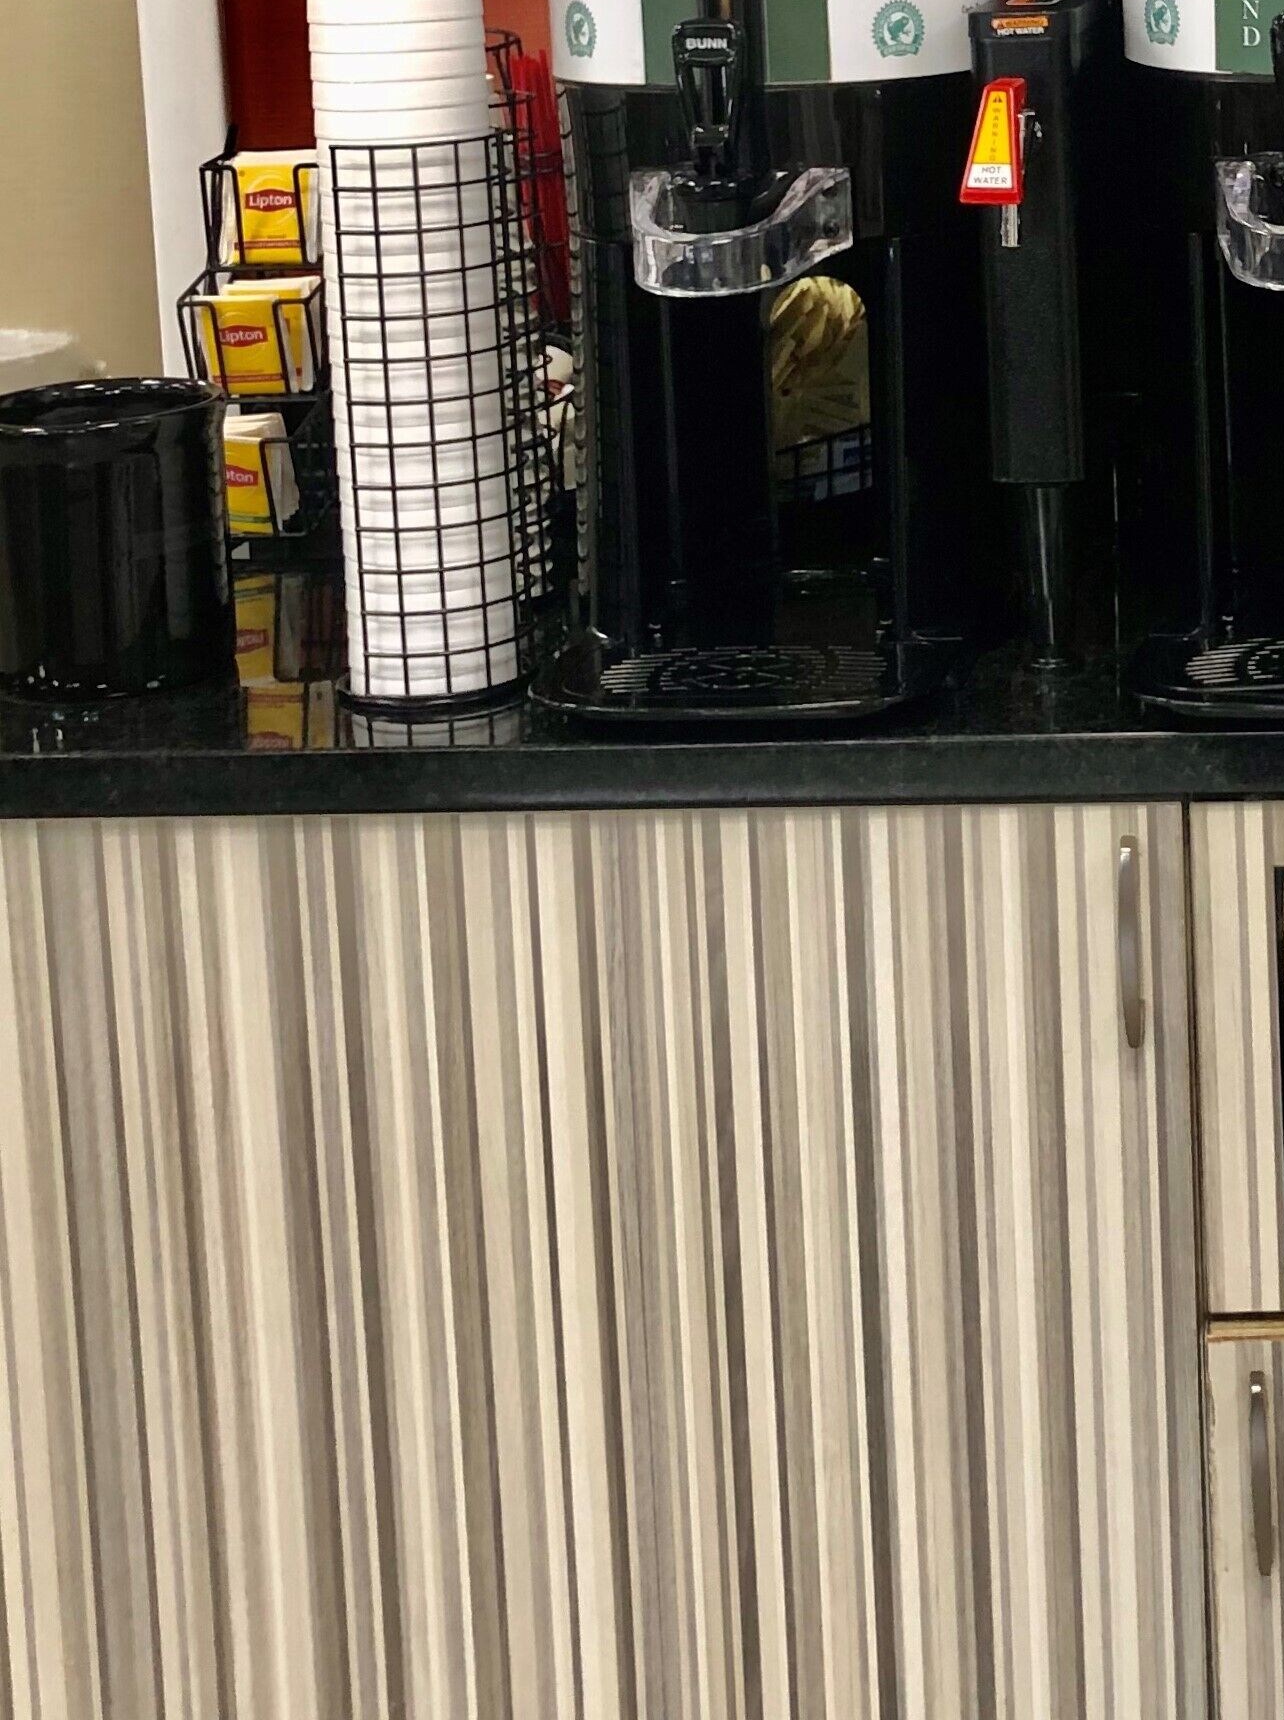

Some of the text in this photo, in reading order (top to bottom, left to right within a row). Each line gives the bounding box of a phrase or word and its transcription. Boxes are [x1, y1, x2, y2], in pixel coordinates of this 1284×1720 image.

[686, 38, 728, 49] BUNN
[981, 166, 1002, 175] HOT
[973, 176, 1008, 185] WATER
[248, 193, 293, 209] Lipton
